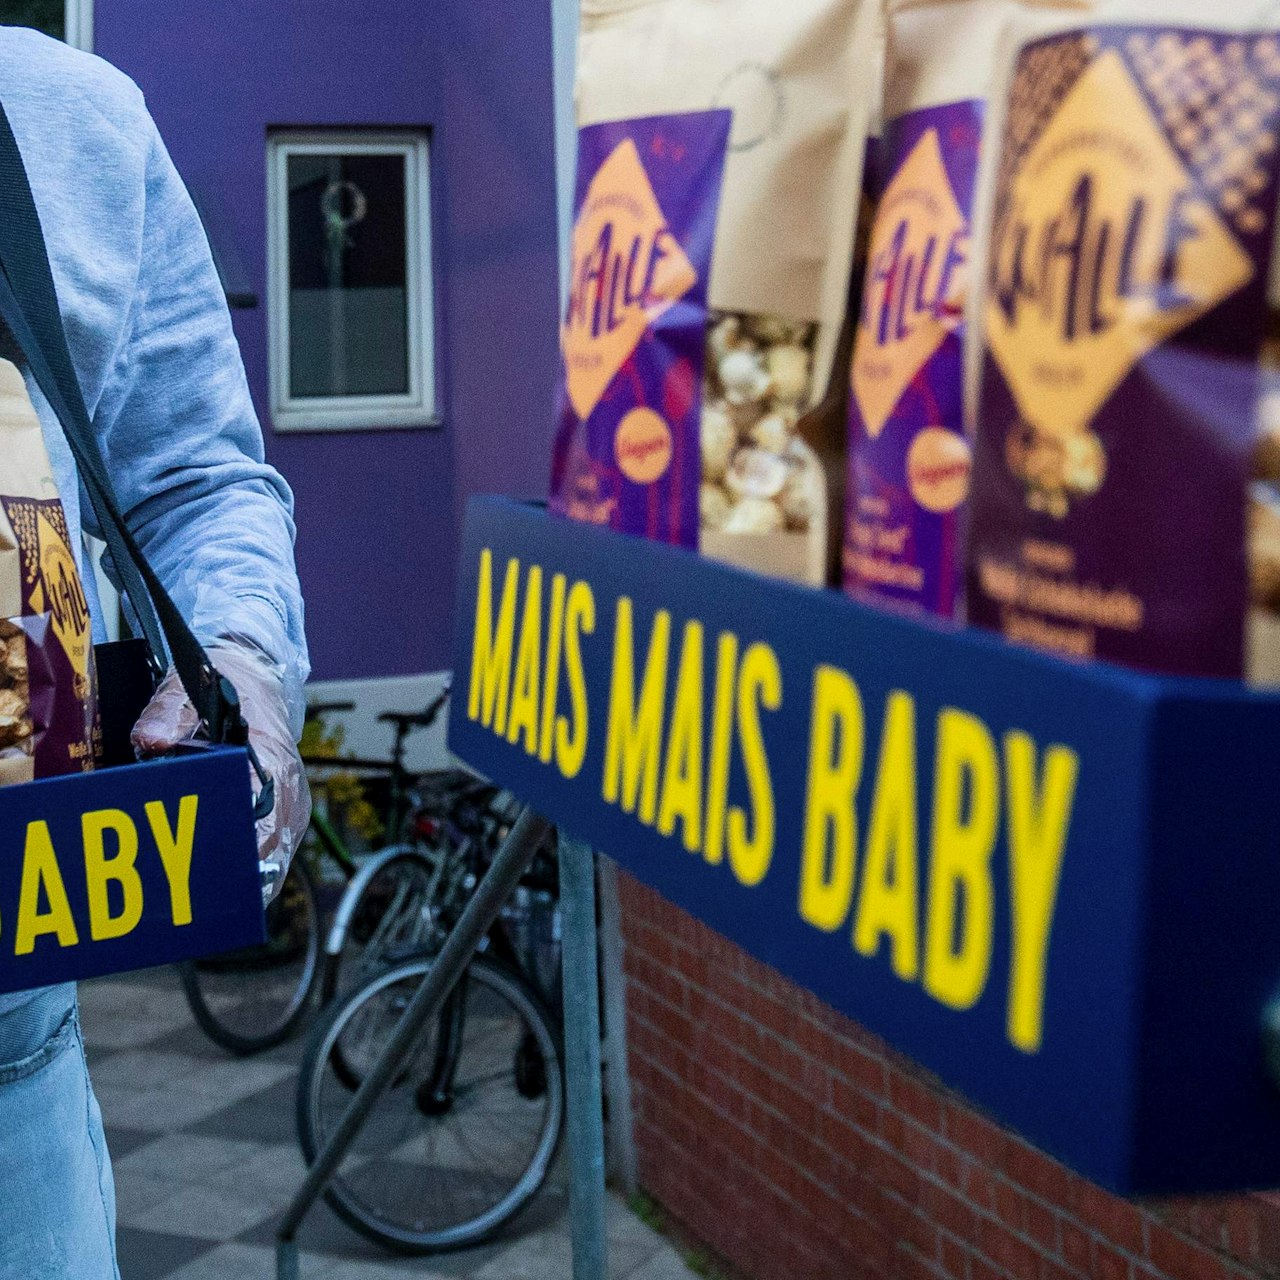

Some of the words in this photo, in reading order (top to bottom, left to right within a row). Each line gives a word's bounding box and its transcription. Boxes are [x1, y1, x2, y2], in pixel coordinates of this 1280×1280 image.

[467, 548, 596, 779] MAIS
[602, 596, 782, 887] MAIS
[798, 663, 1080, 1054] BABY
